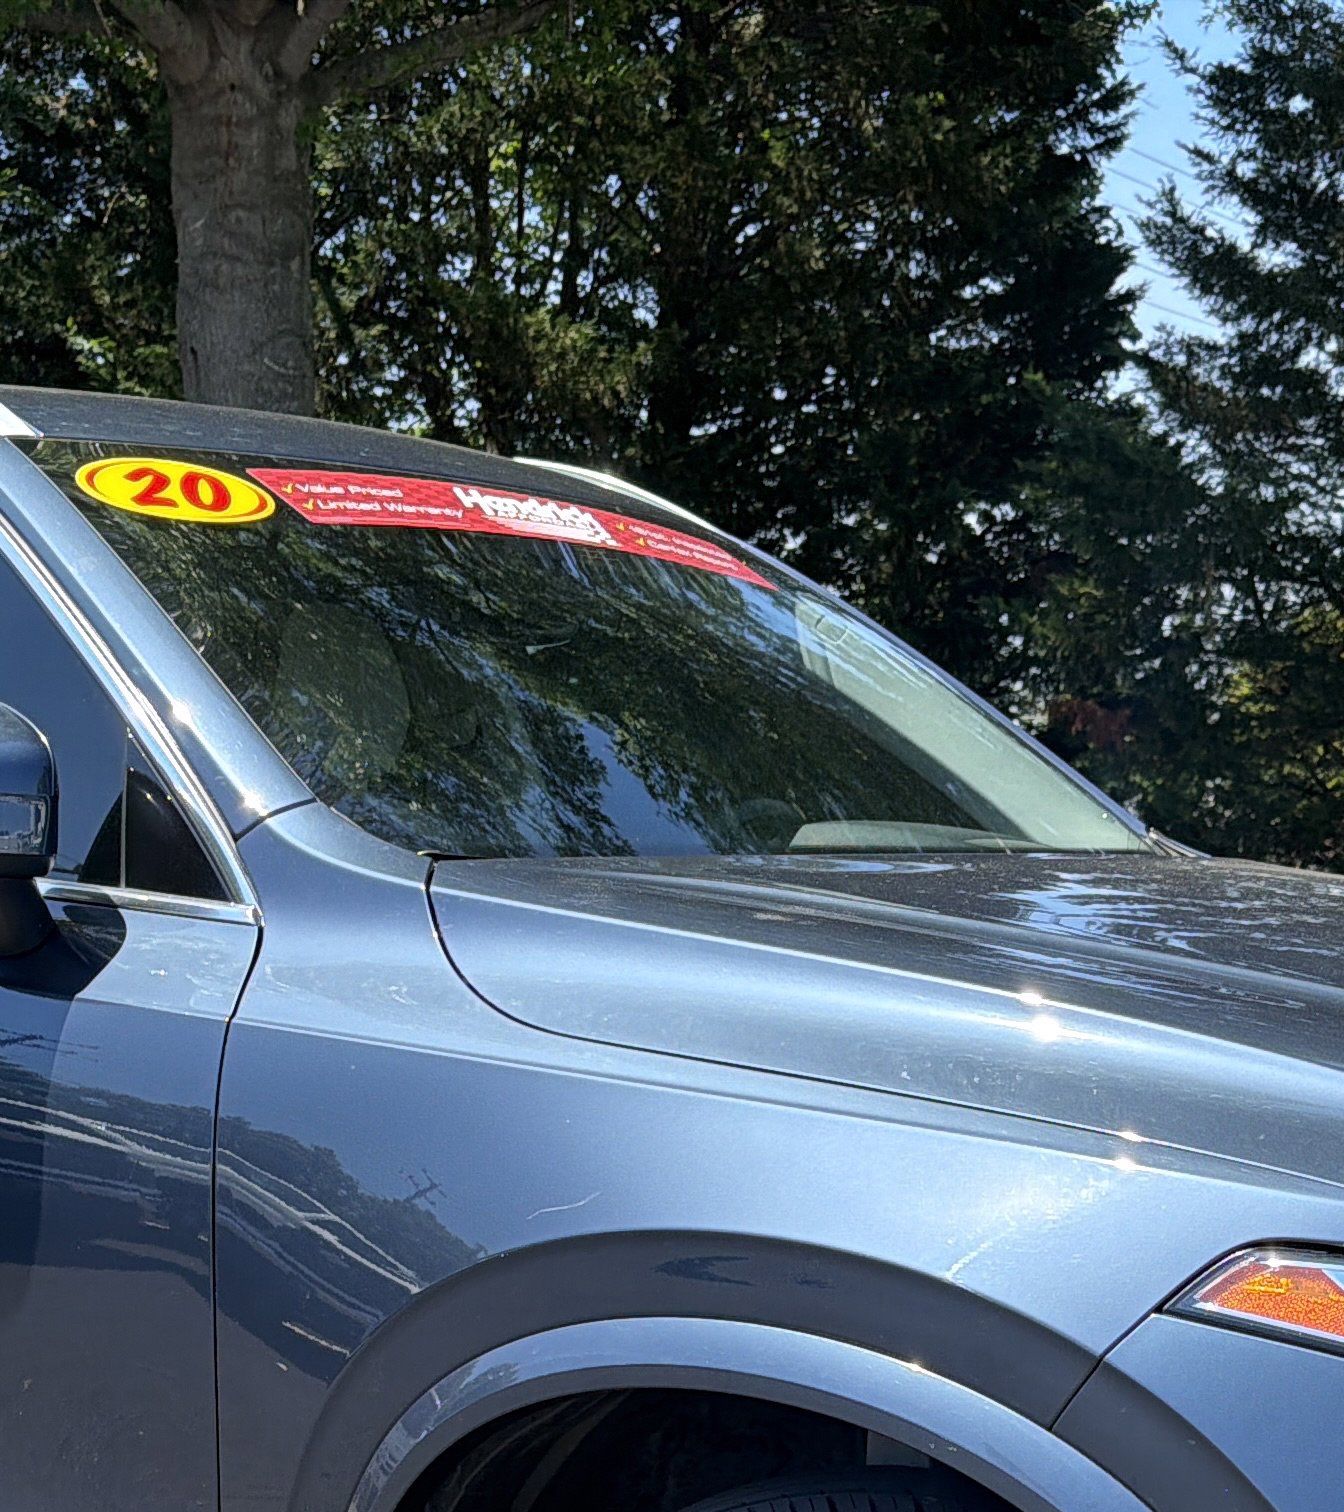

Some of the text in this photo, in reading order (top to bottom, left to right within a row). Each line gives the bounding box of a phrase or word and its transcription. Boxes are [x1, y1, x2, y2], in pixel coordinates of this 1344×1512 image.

[123, 466, 232, 513] 20
[295, 483, 404, 498] Value Priced
[316, 499, 464, 519] Limited Warranty
[452, 486, 611, 539] Hendrick
